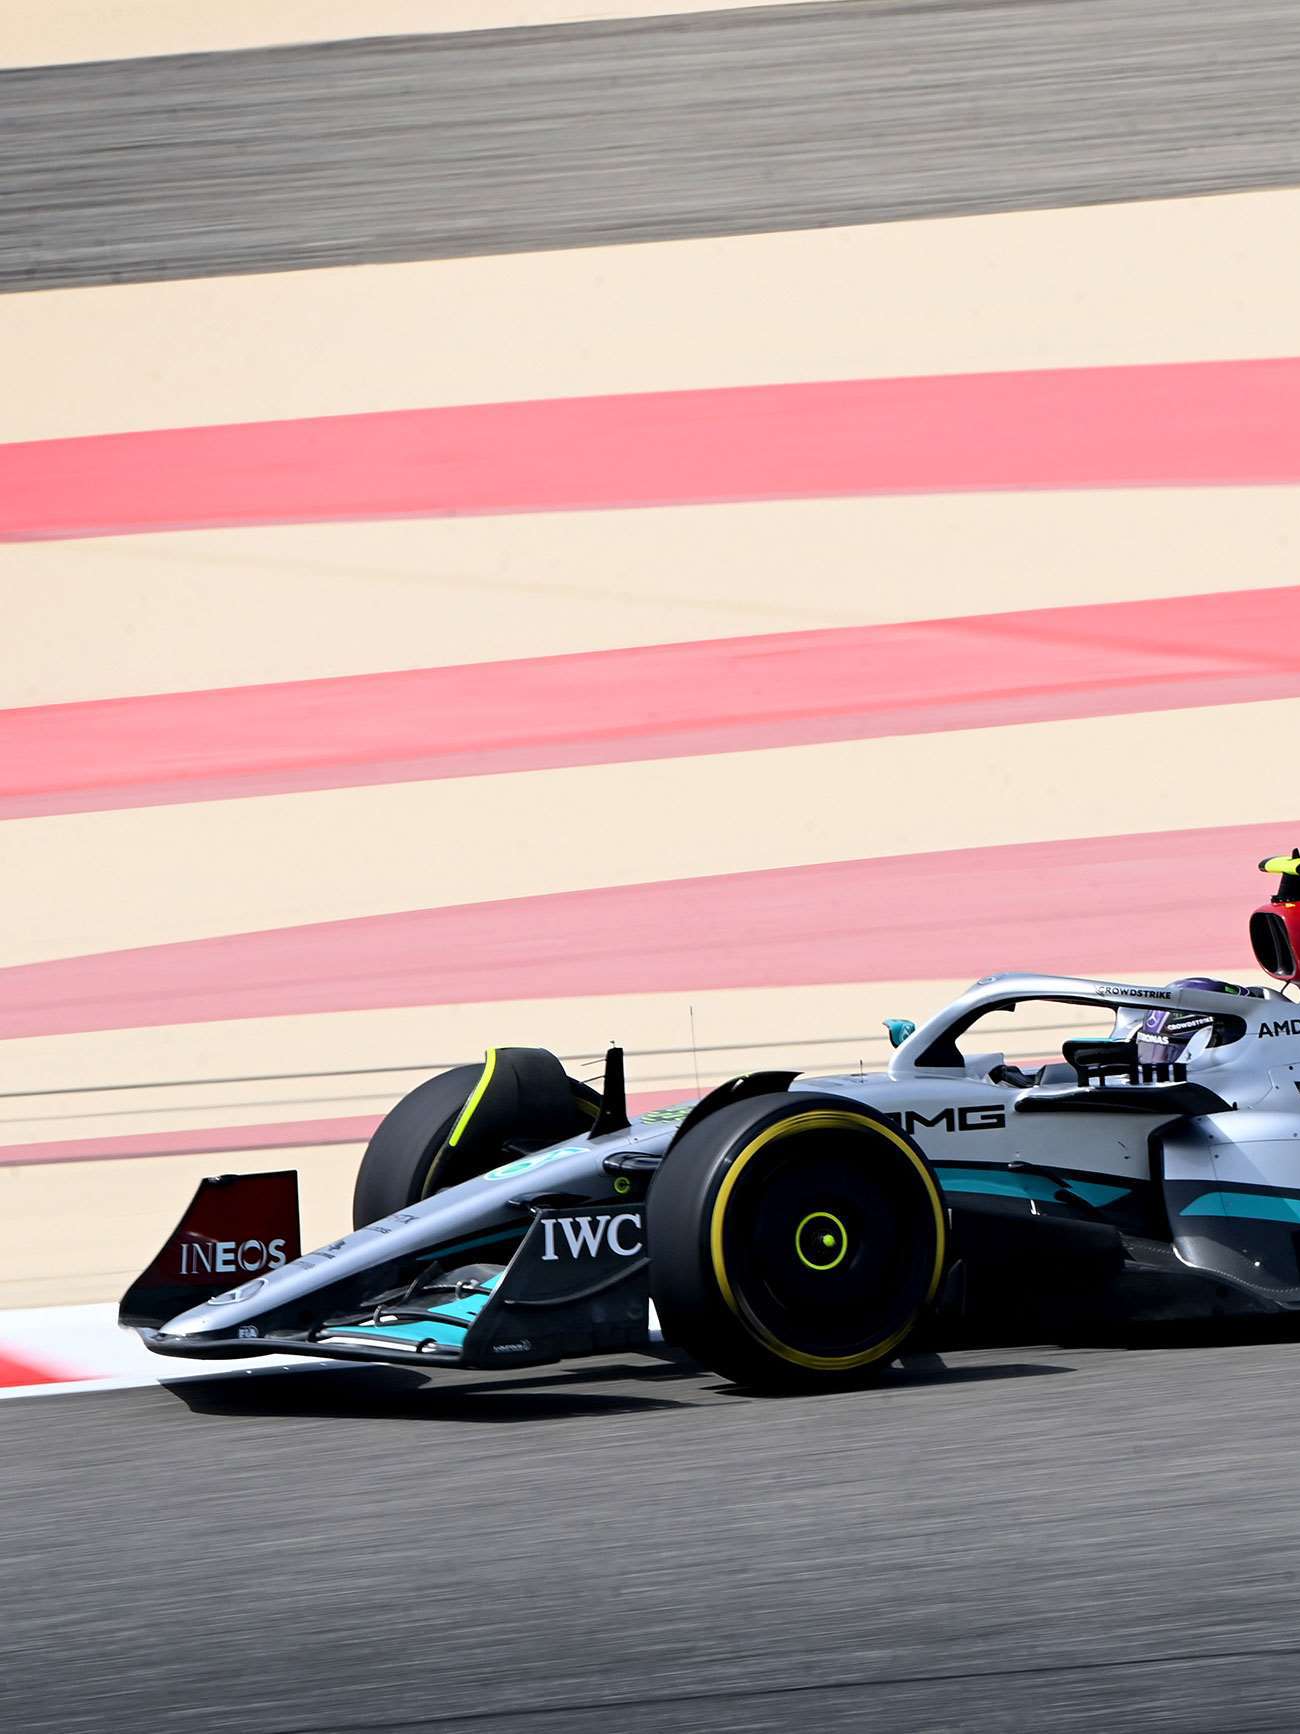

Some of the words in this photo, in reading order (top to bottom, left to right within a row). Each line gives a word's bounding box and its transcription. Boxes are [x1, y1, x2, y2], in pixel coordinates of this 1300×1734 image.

[1096, 985, 1172, 1000] CROWDSTRIKE
[540, 1213, 643, 1261] IWC
[179, 1238, 287, 1275] INEOS
